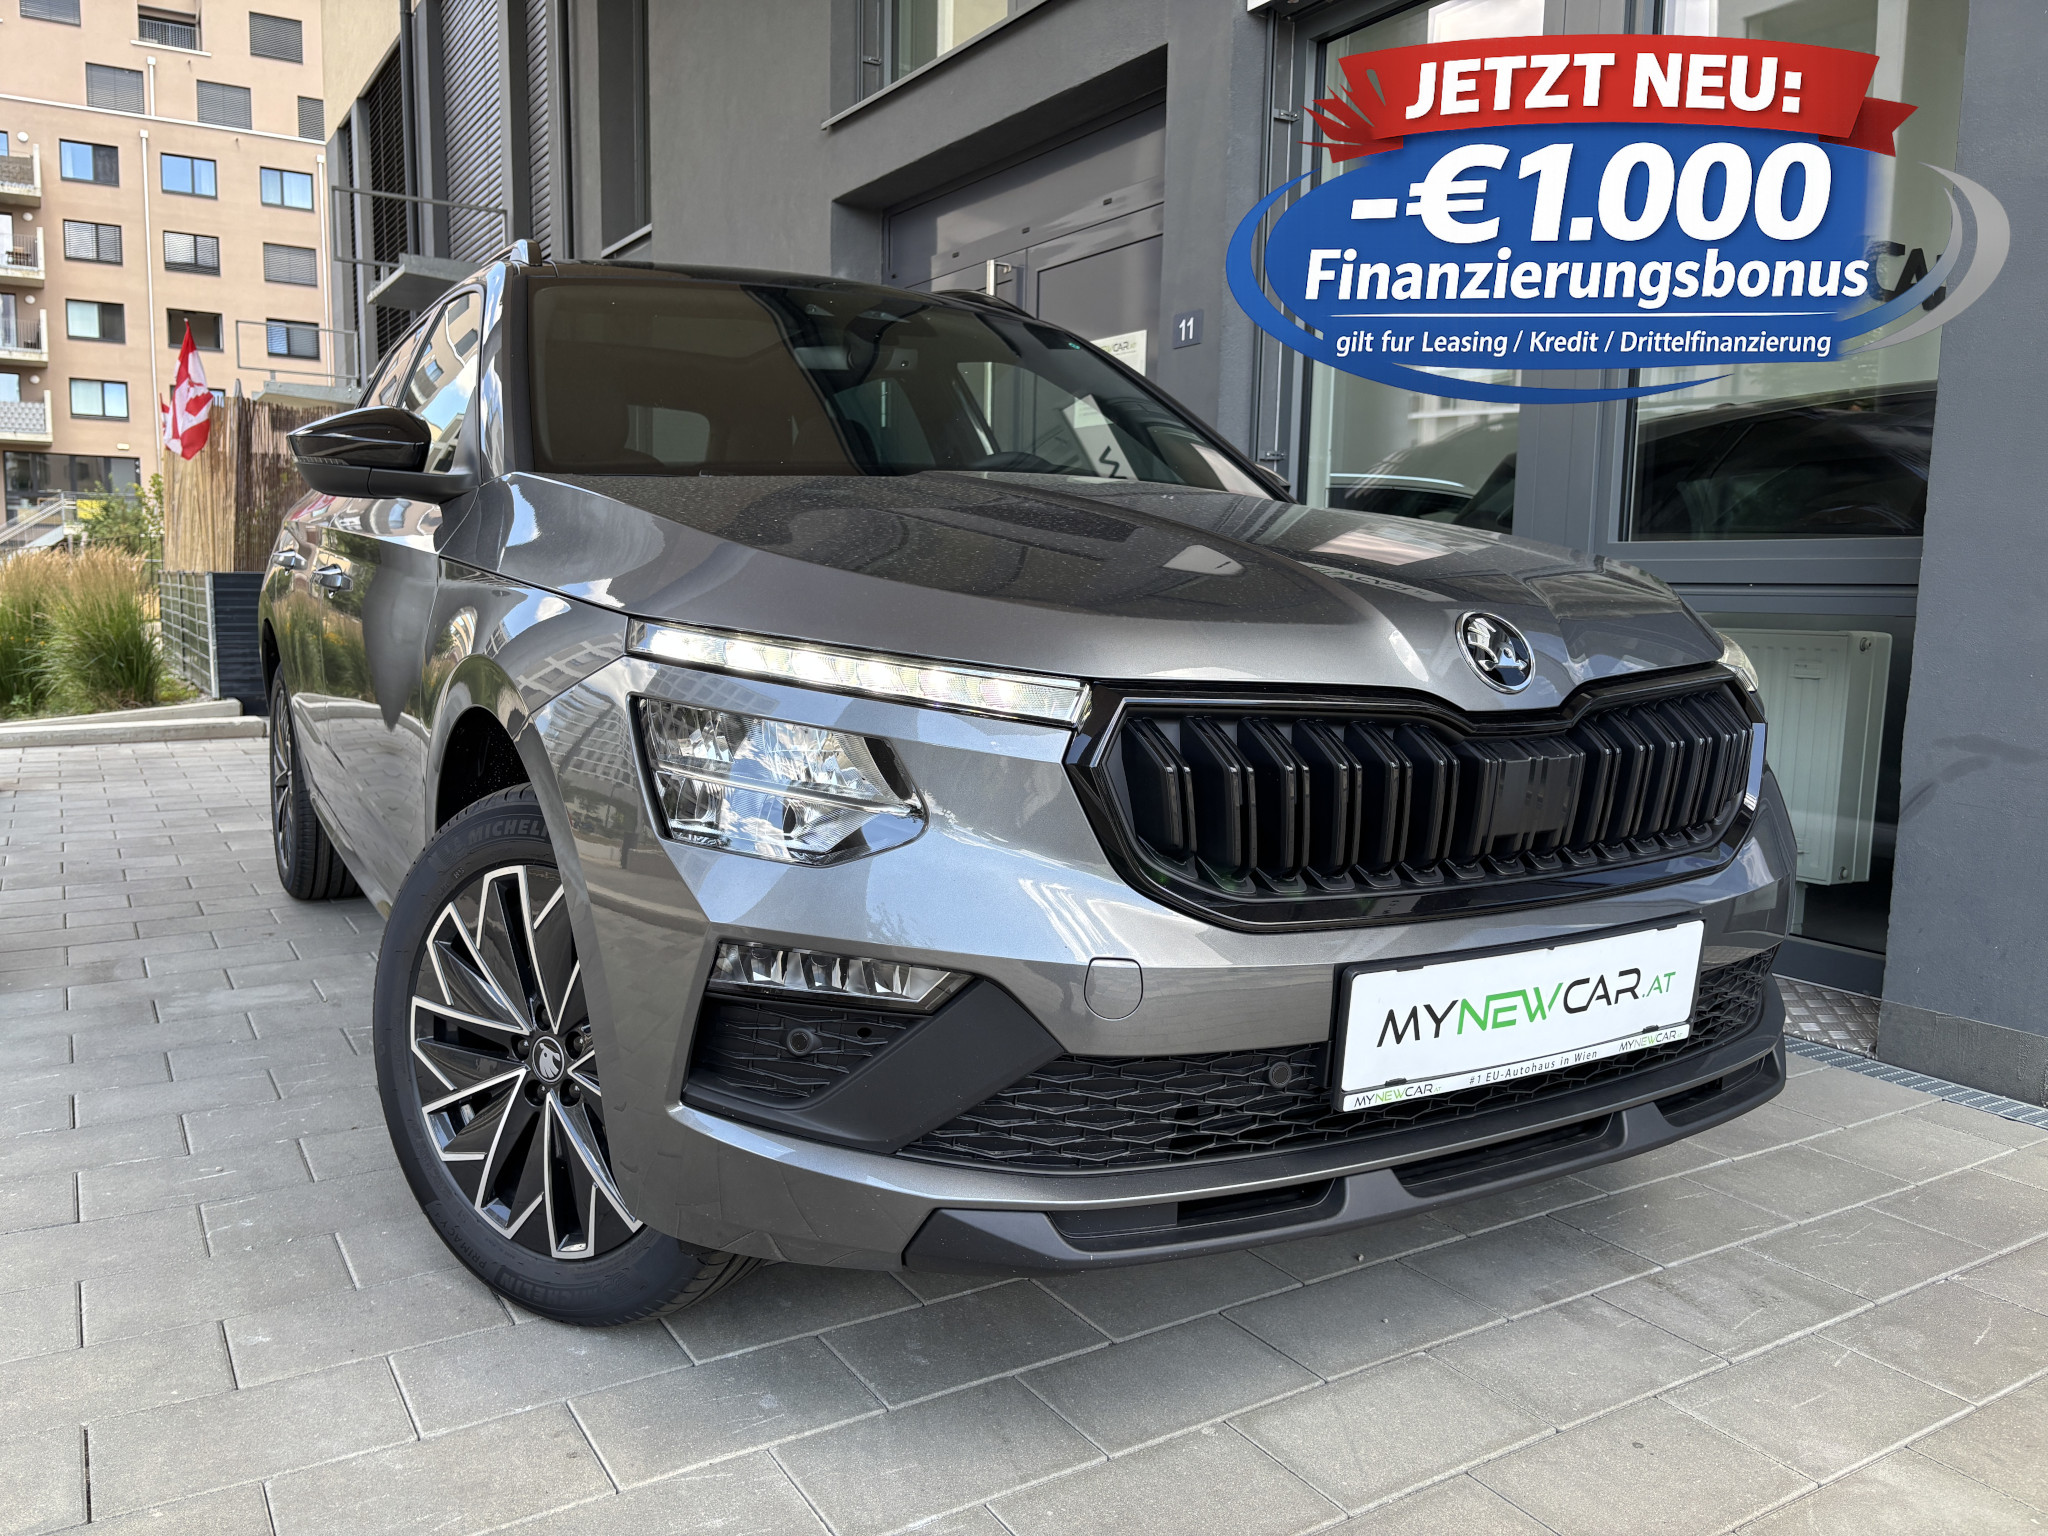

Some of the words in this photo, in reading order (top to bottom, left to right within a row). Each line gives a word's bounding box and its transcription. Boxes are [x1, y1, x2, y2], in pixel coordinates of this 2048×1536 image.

[1864, 240, 1947, 311] CA
[1178, 316, 1194, 341] 11
[1376, 967, 1676, 1048] MYNEWCAR.AT
[1485, 1059, 1556, 1083] EU-Autohaus
[1560, 1055, 1570, 1067] in
[1574, 1049, 1598, 1063] Wien
[499, 1271, 601, 1305] MICHELIN
